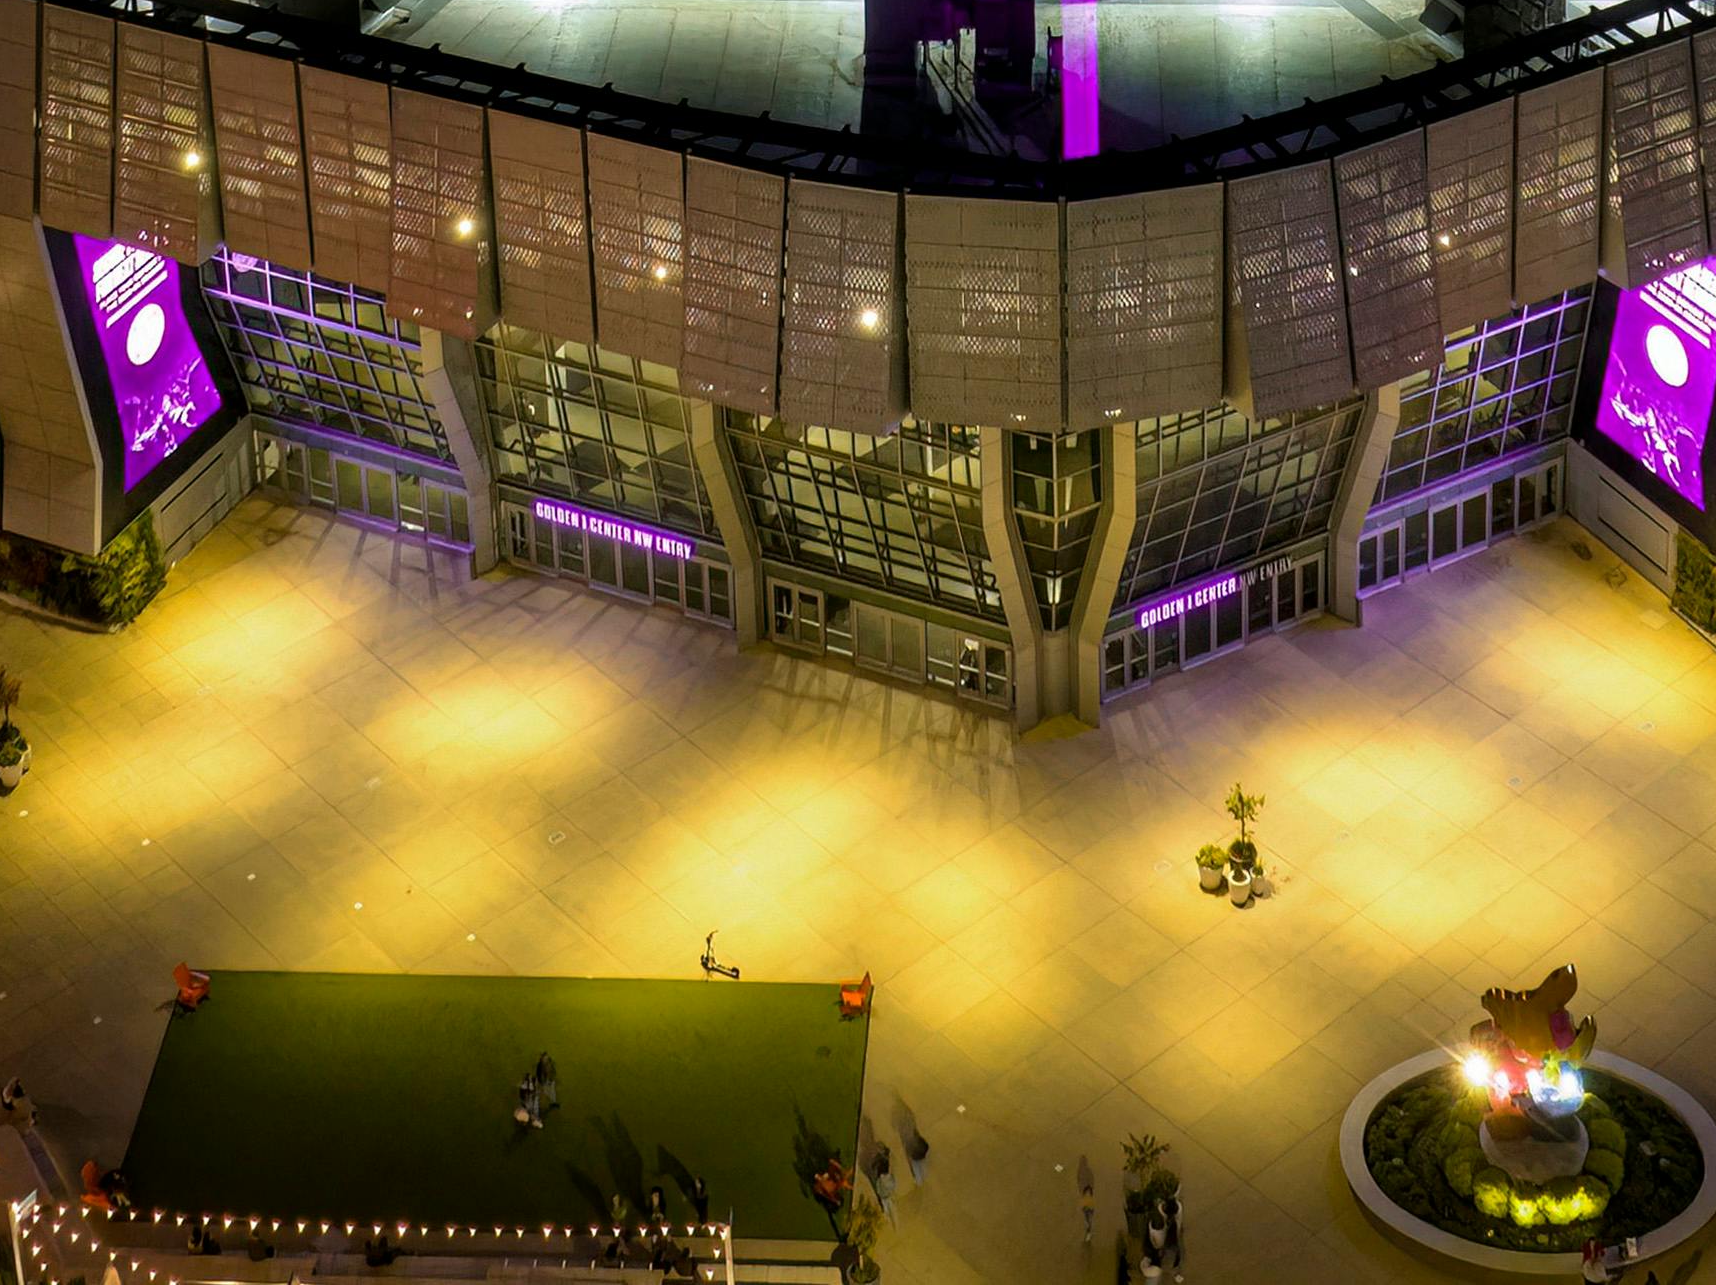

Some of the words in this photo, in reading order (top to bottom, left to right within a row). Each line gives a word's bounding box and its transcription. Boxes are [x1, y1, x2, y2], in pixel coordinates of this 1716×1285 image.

[536, 502, 579, 528] GOLDEN
[589, 517, 631, 543] CENTER
[634, 530, 653, 549] NW
[656, 537, 692, 560] ENTRY
[1141, 599, 1184, 629] GOLDEN
[1194, 577, 1236, 608] CENTER
